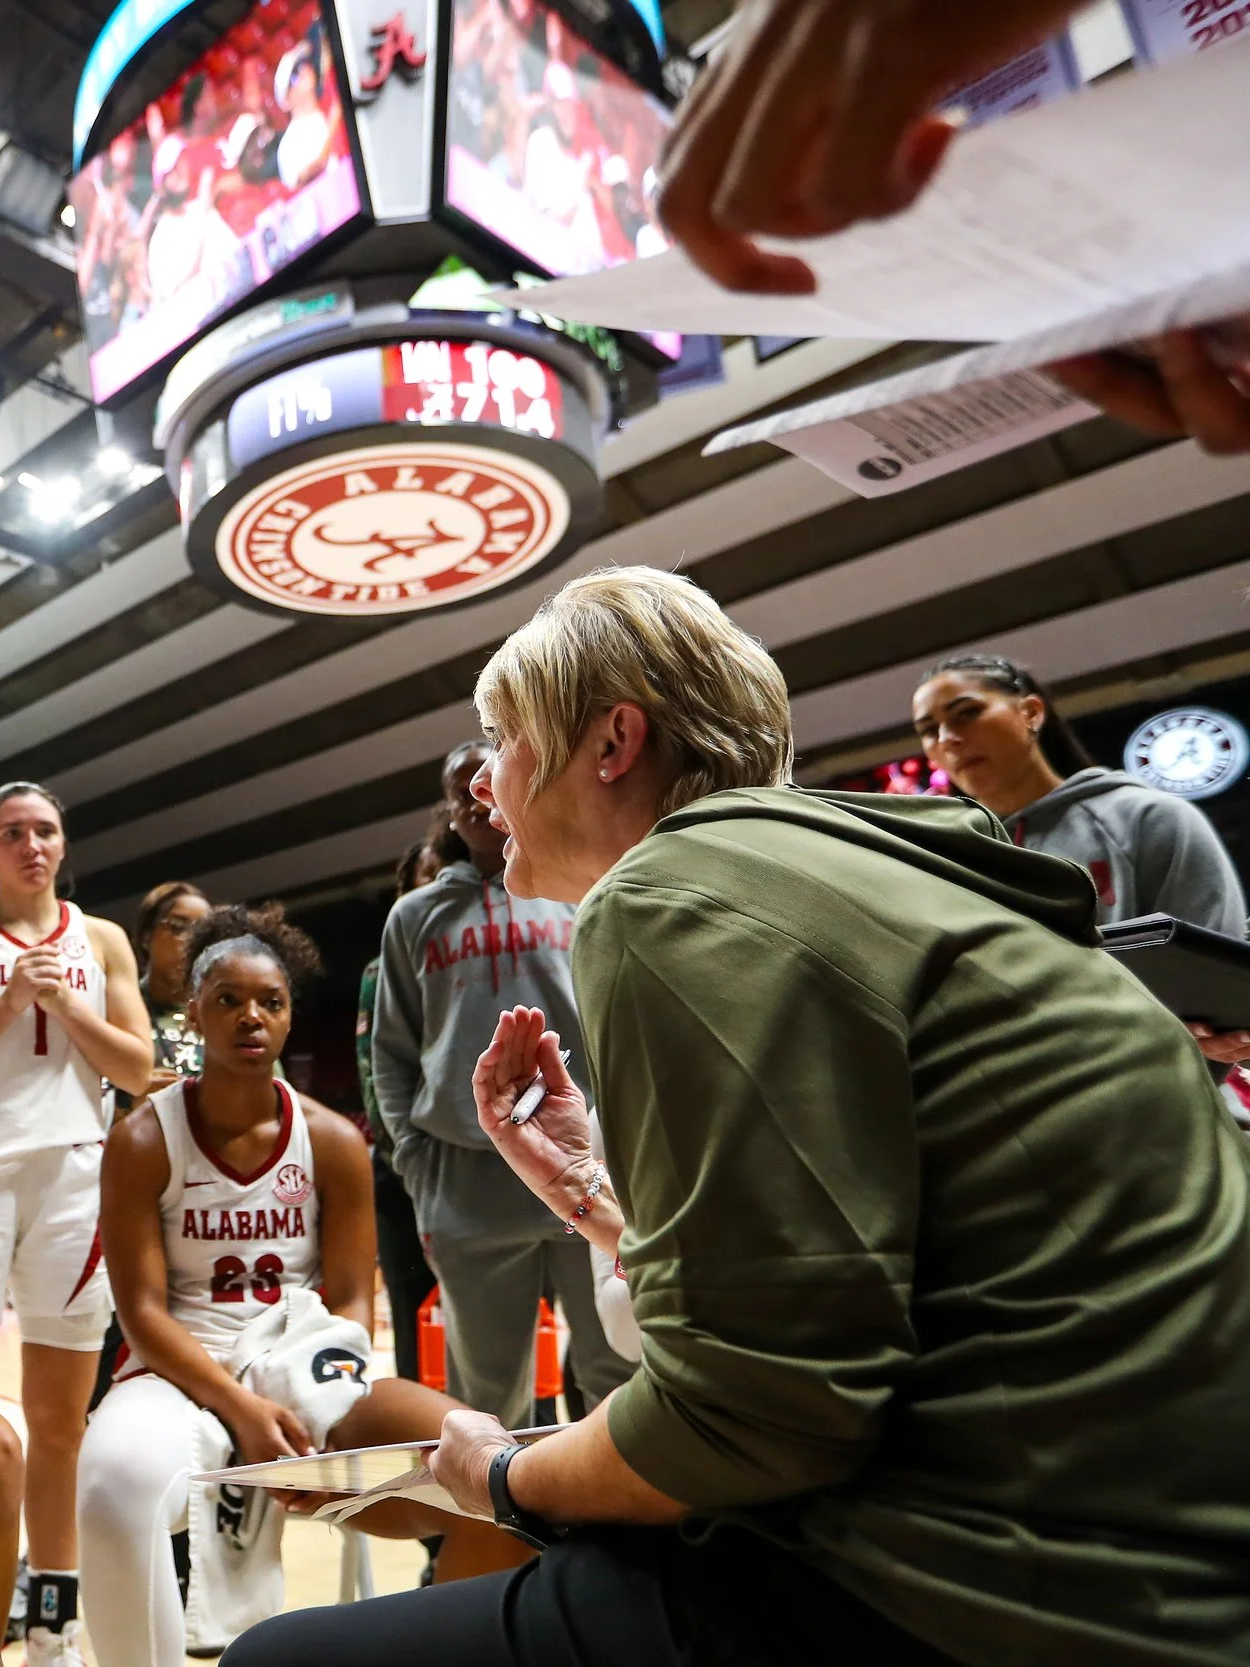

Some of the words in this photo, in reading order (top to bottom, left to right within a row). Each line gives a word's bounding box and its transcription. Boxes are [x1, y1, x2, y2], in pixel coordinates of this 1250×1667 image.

[344, 466, 531, 575] ALABAMA
[250, 499, 327, 597] CRIMSON
[327, 580, 430, 601] TIDE
[34, 1001, 48, 1056] 1
[182, 1207, 306, 1241] ALABAMA
[211, 1253, 284, 1306] 23
